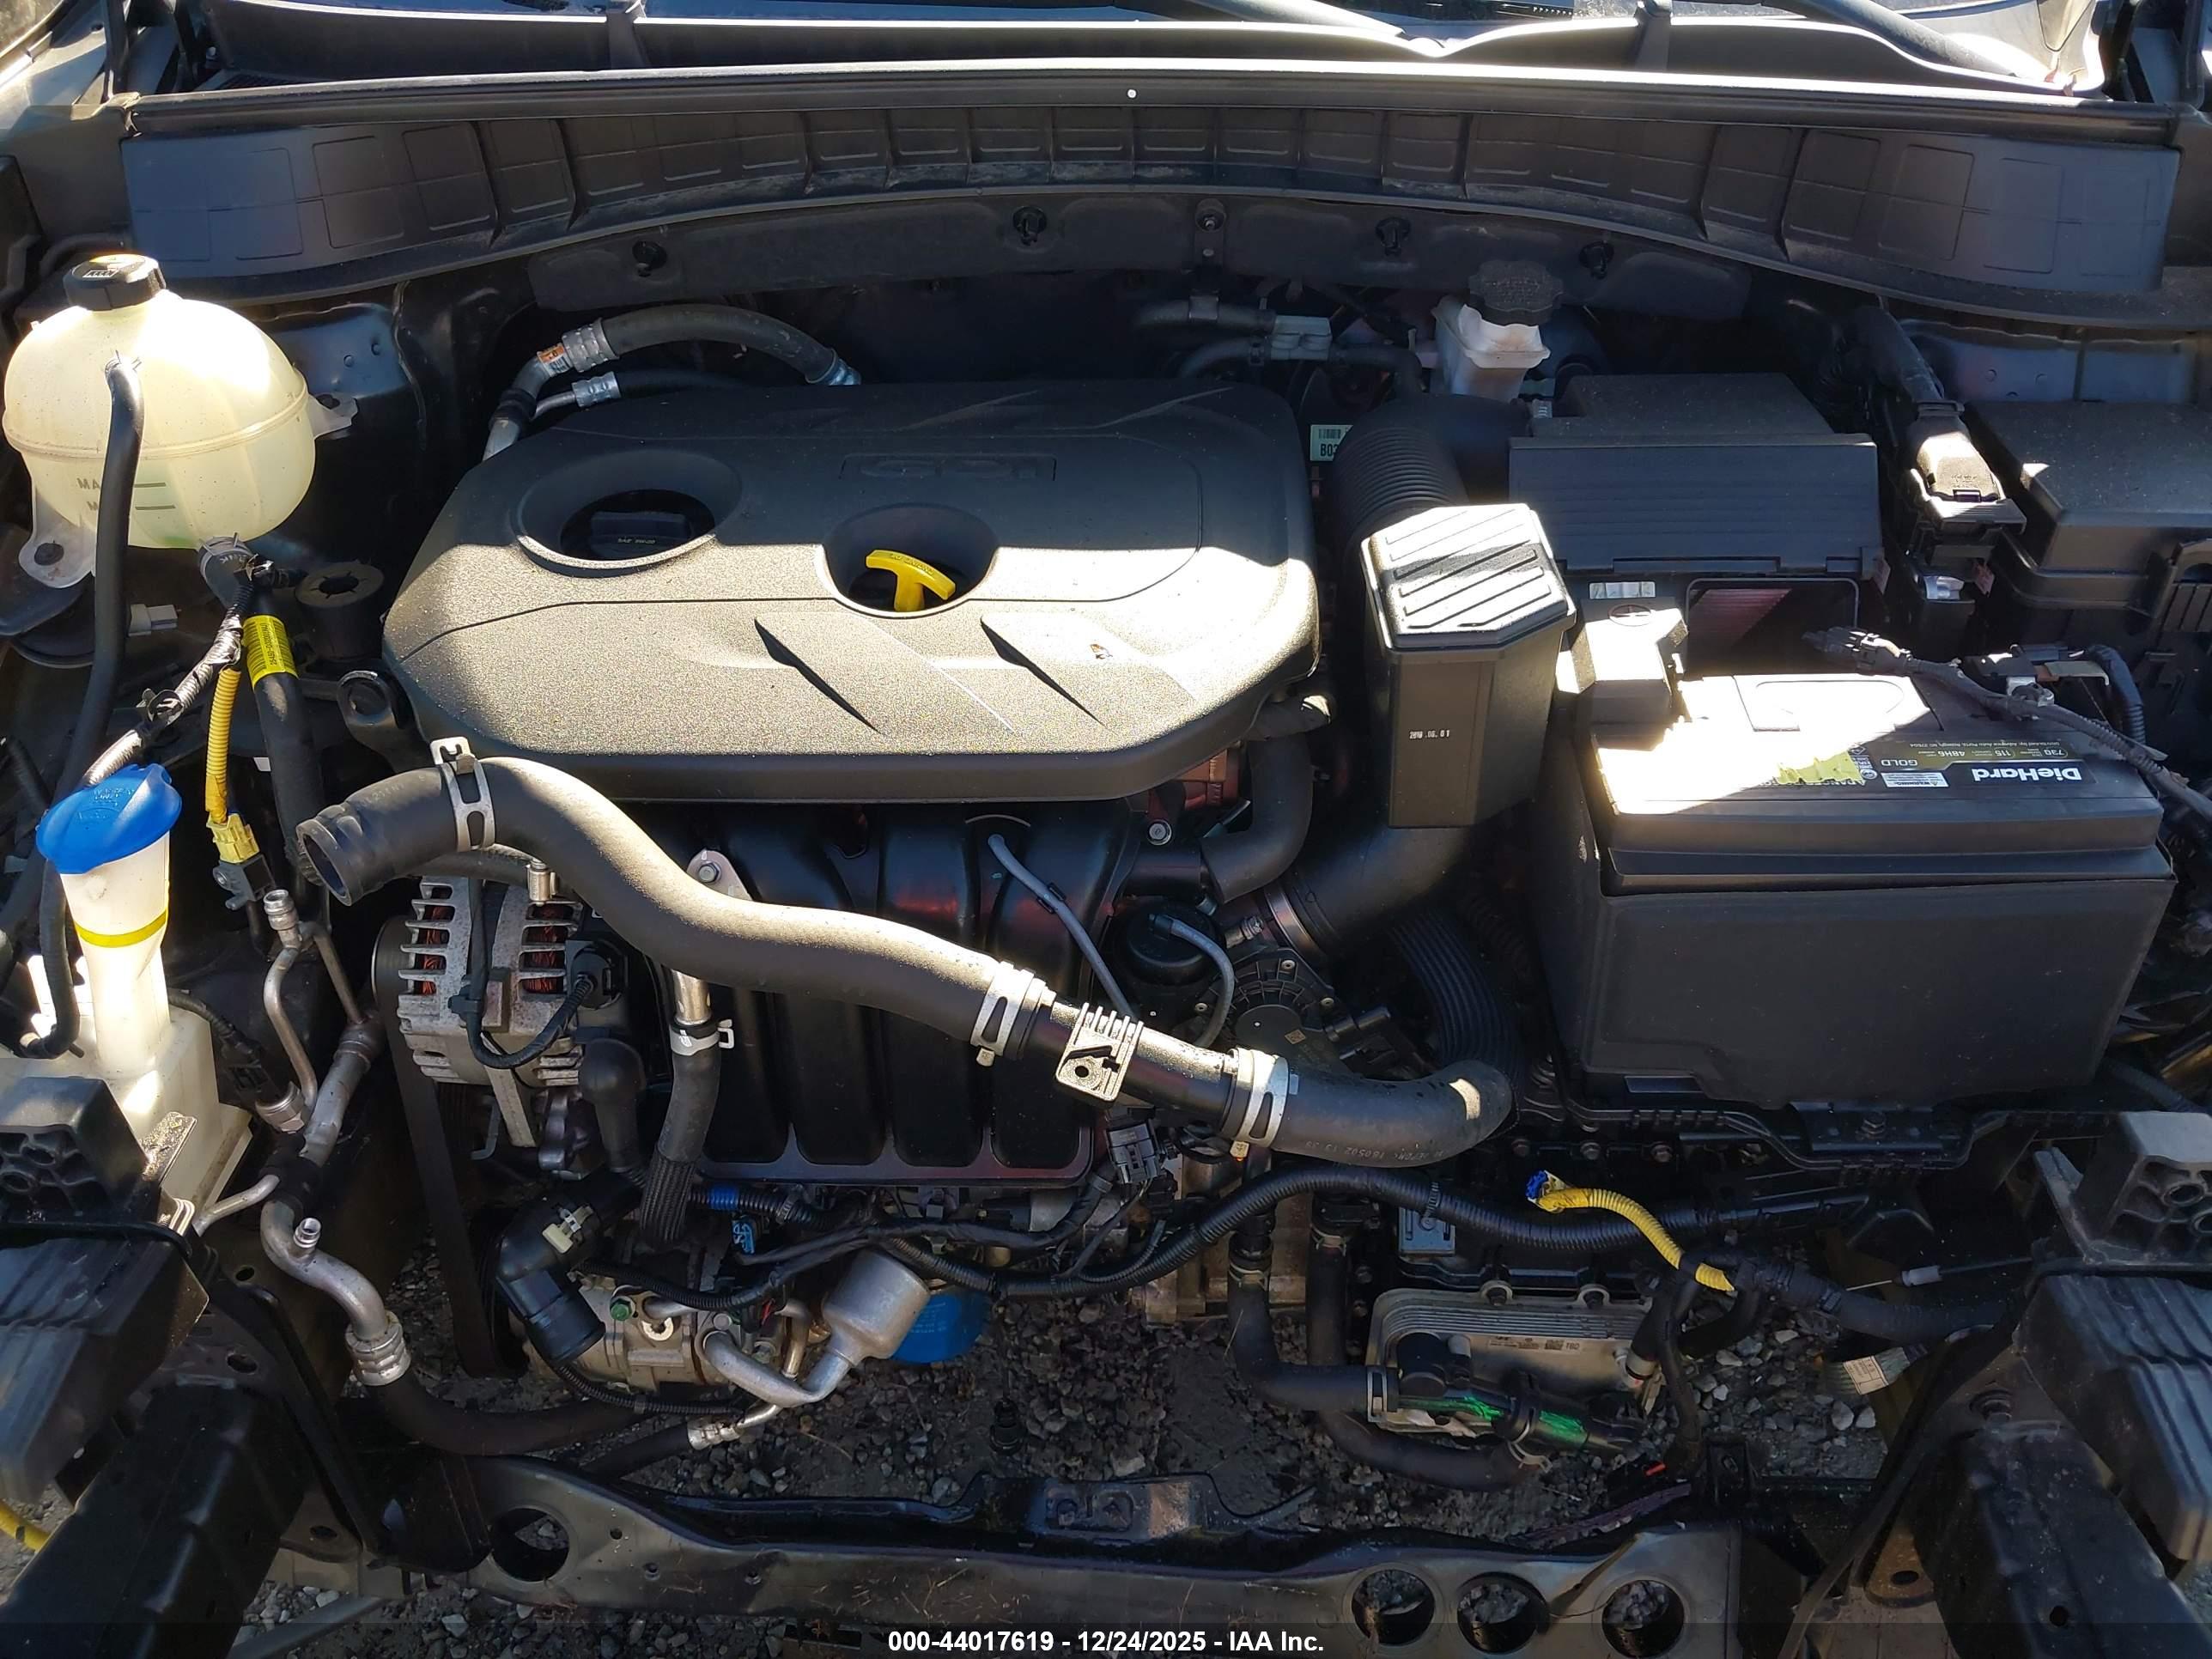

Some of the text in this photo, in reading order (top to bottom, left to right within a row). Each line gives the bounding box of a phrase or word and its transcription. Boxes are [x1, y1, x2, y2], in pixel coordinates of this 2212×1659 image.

[76, 477, 100, 490] MA
[1994, 749, 2011, 757] 115
[2043, 748, 2064, 757] 730
[1880, 758, 1918, 767] GOLD
[1972, 767, 2082, 781] DieHard
